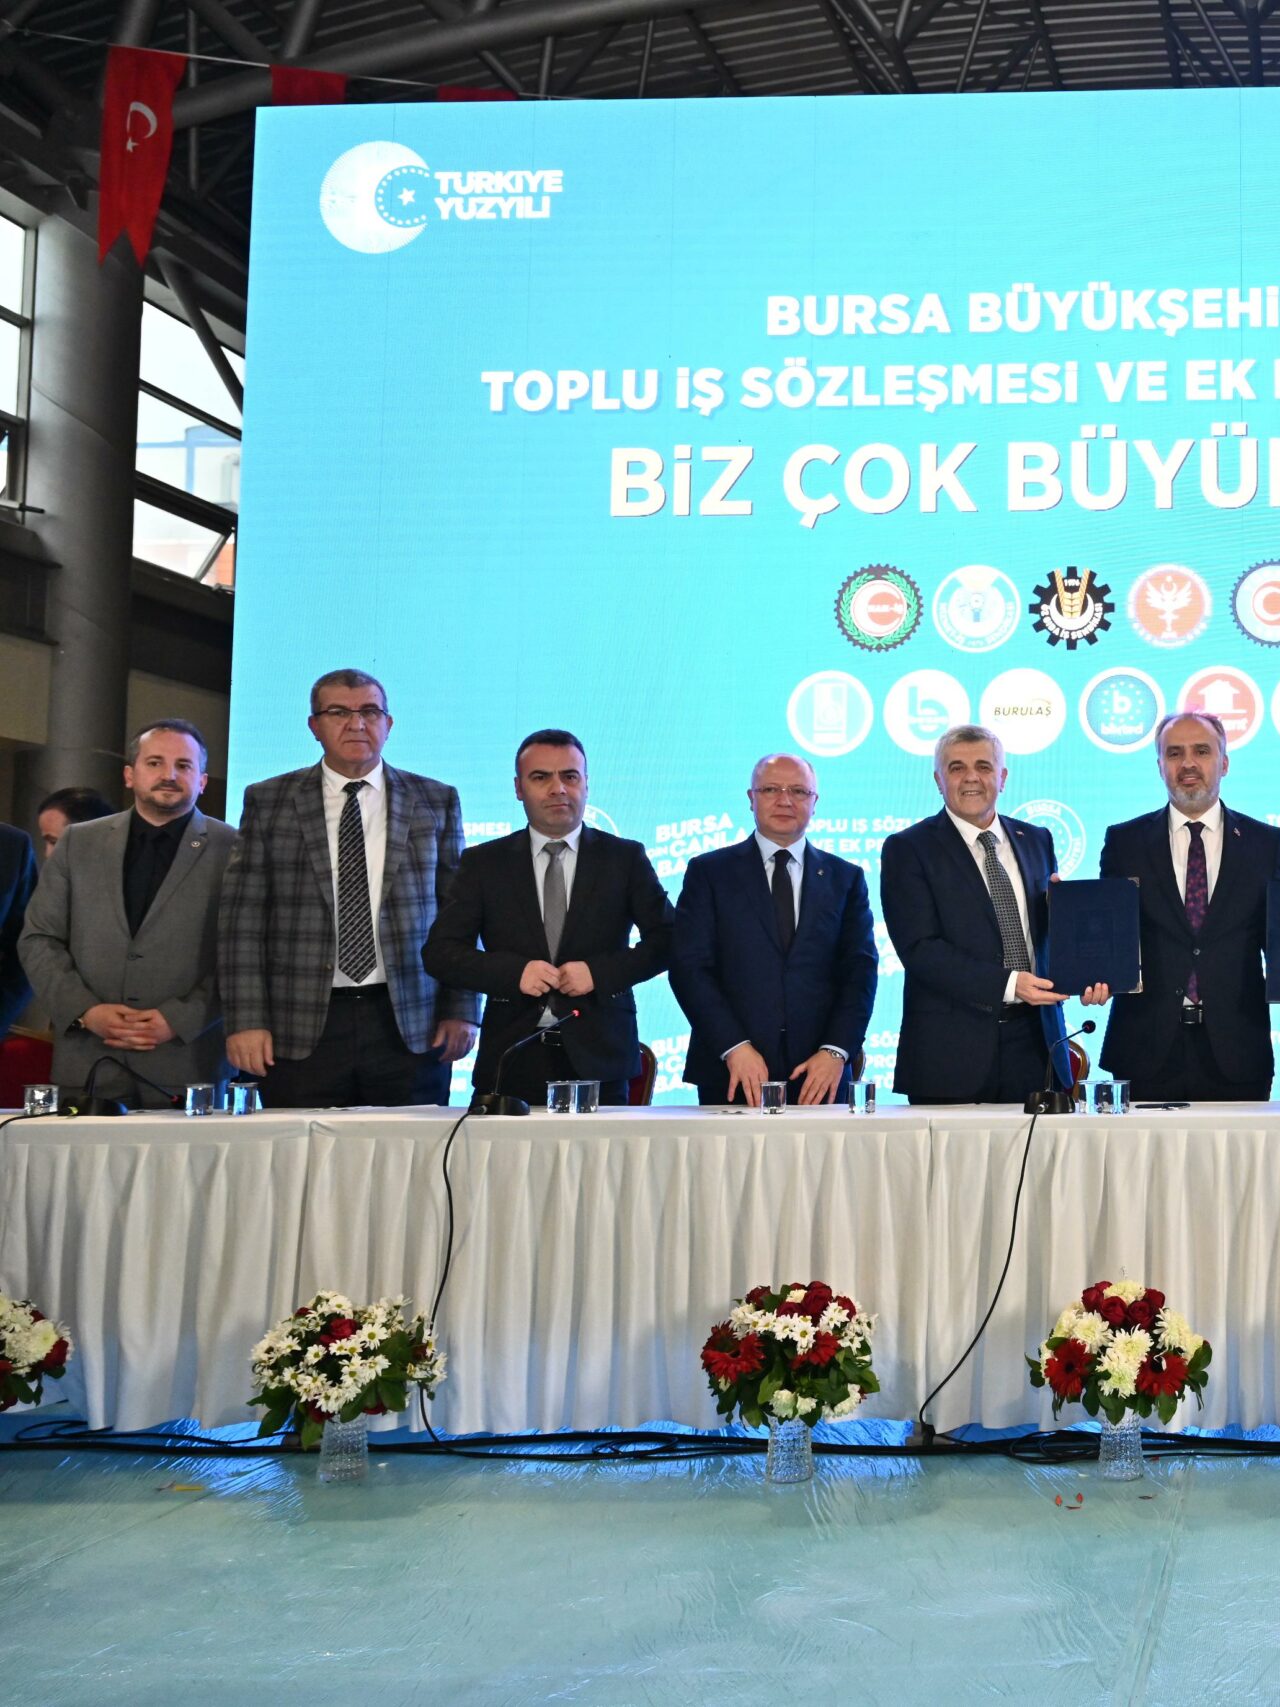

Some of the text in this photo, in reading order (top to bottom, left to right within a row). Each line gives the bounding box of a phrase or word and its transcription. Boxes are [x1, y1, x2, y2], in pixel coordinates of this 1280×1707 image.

[767, 292, 951, 335] BURSA
[481, 368, 658, 412] TOPLU
[1096, 360, 1168, 402] VE
[1186, 359, 1257, 401] EK
[783, 442, 978, 529] ÇOK
[994, 706, 1052, 717] BURULAŞ
[656, 813, 733, 843] BURSA
[805, 818, 847, 832] OPLU
[840, 838, 860, 852] EK
